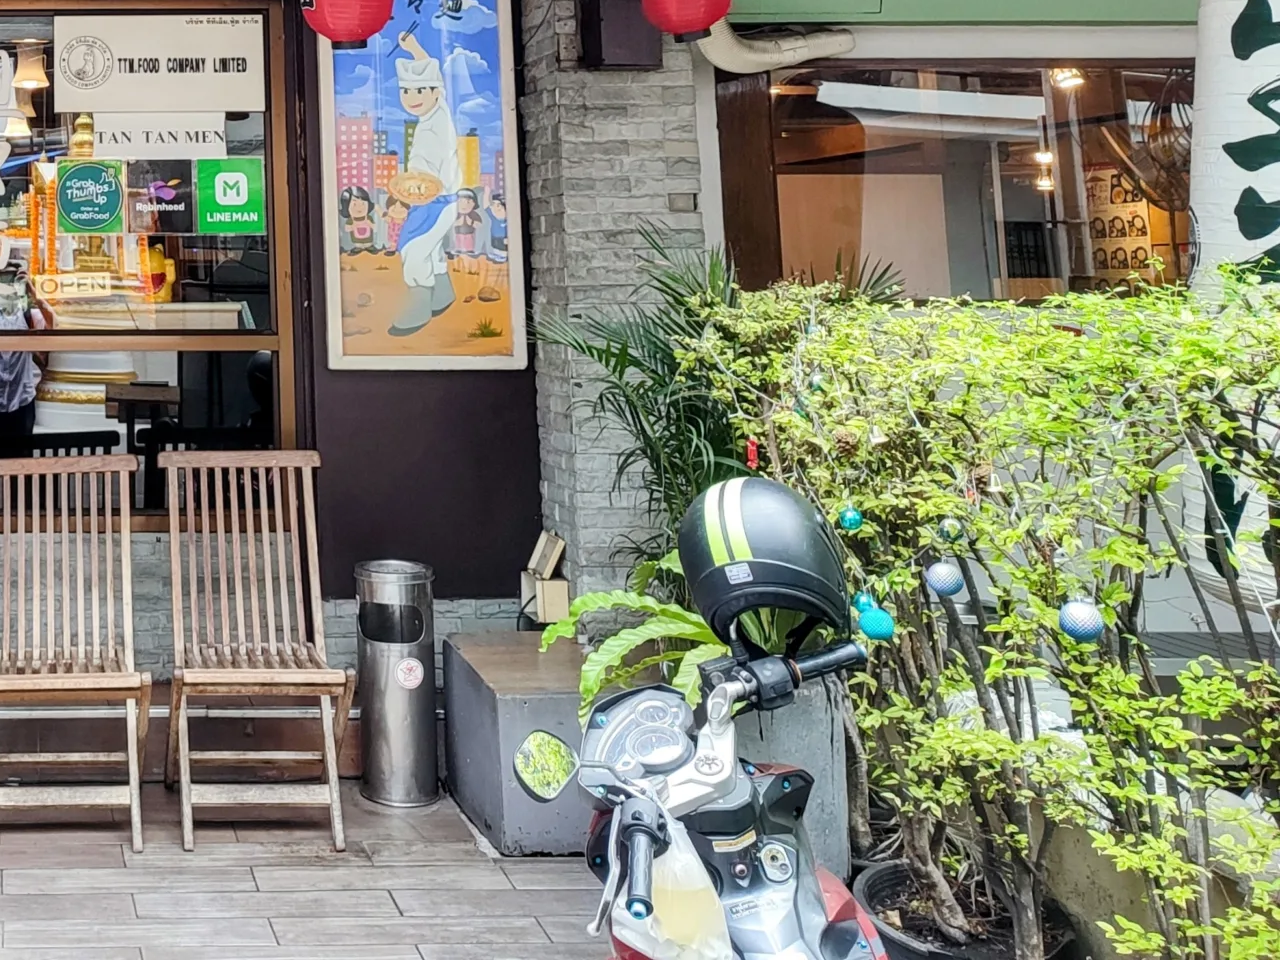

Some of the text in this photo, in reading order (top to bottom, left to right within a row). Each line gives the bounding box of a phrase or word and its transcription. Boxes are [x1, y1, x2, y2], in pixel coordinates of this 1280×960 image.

[117, 57, 247, 74] TTM.FOOD COMPANY LIMITED
[94, 130, 225, 145] TAN TAN MEN
[70, 211, 110, 220] GrabFood
[39, 276, 108, 295] OPEN
